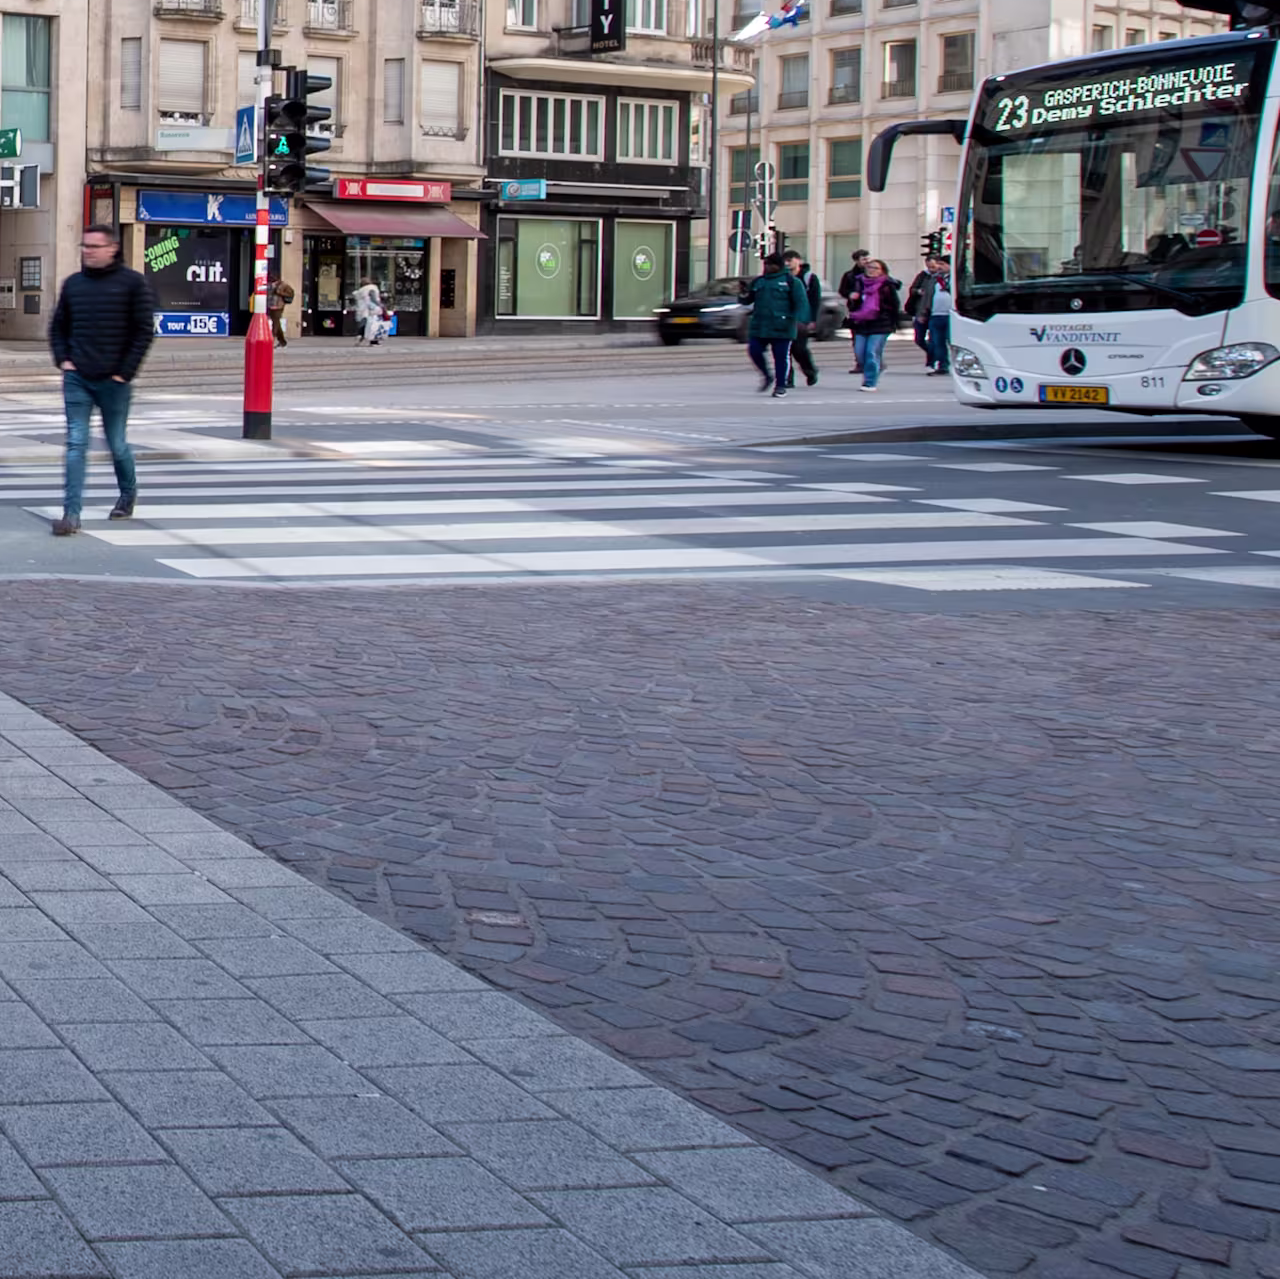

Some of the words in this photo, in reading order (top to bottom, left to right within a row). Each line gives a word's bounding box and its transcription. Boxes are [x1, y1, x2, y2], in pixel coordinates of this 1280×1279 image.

[592, 39, 620, 49] HOTEL
[1044, 63, 1236, 107] GASPERICH-BONNEVOIE
[1031, 105, 1093, 125] Demy
[1099, 82, 1249, 116] Schlechter
[995, 95, 1029, 132] 23
[144, 236, 180, 262] COMING
[150, 251, 178, 272] SOON
[167, 322, 185, 330] TOUT
[1048, 324, 1093, 332] VOYAGES
[1045, 332, 1121, 342] VANDIVINIT
[1141, 376, 1165, 388] 811
[1069, 389, 1100, 401] 2142
